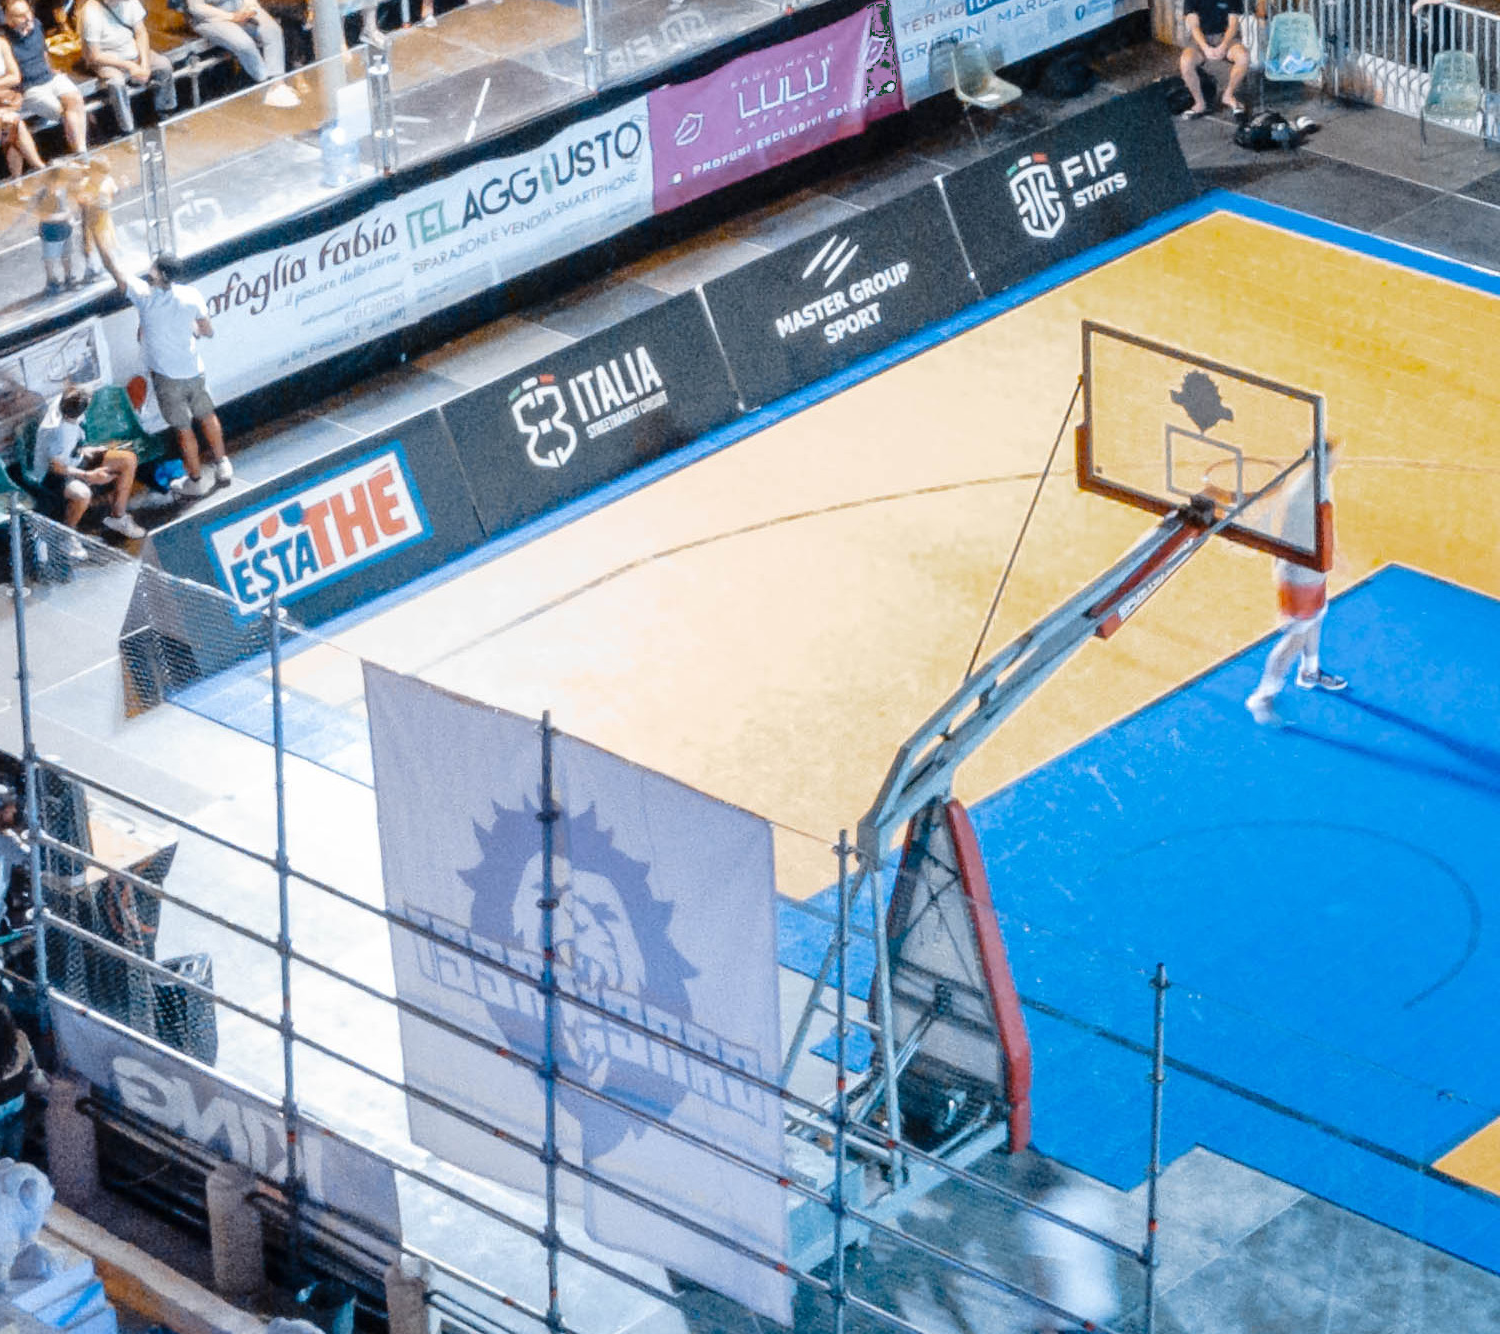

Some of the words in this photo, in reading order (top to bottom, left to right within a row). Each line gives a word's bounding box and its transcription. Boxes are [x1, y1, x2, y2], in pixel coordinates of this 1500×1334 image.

[1059, 140, 1119, 188] FIP
[554, 168, 639, 215] SMARTPHONE
[1072, 171, 1129, 209] STATS
[774, 288, 849, 339] MASTER
[848, 261, 912, 304] GROUP
[823, 301, 883, 345] SPORT
[567, 345, 664, 423] ITALIA
